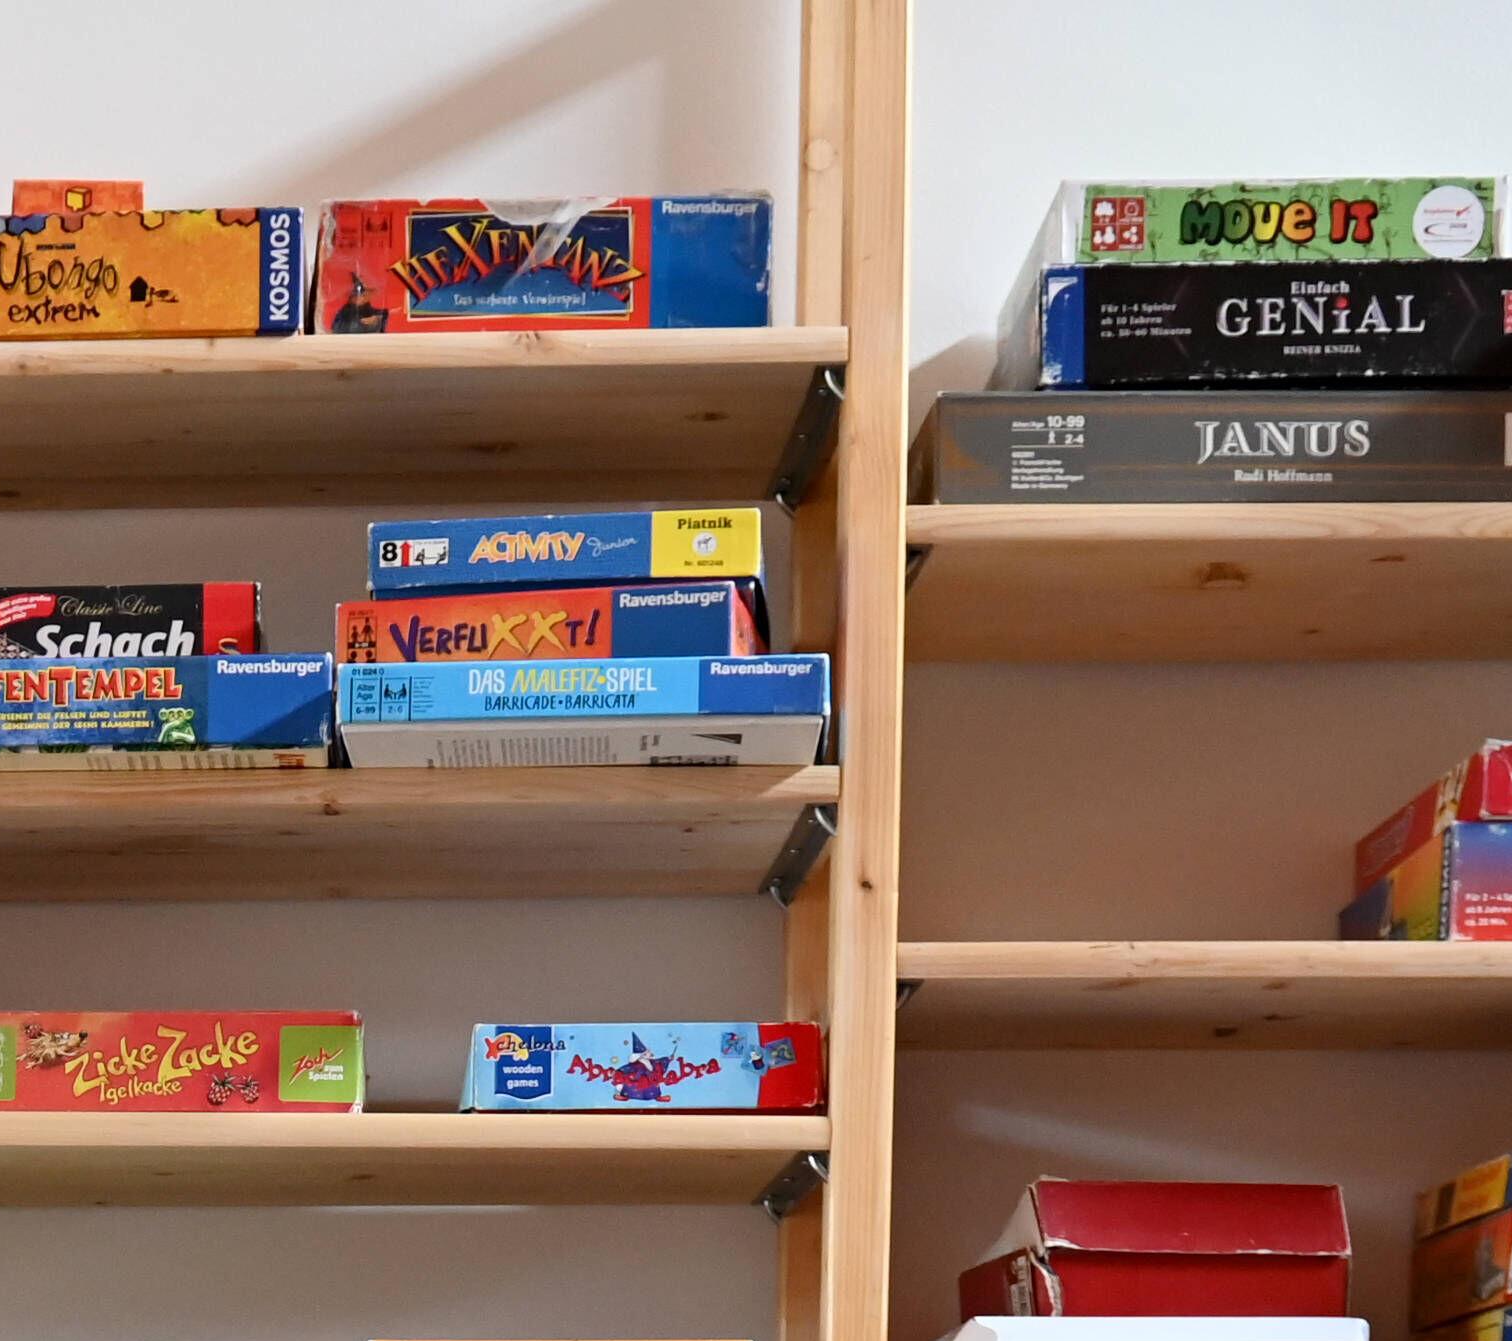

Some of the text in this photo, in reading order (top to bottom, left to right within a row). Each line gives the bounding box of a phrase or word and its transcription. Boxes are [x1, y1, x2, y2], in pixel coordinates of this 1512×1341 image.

[1329, 198, 1377, 242] IT
[269, 212, 290, 321] KOSMOS
[1290, 280, 1350, 295] Einfach
[8, 302, 100, 324] extrem
[1195, 420, 1371, 464] JANUS
[677, 517, 732, 531] Piatnik
[469, 532, 585, 563] ACTIVITY
[34, 622, 195, 658] Schach
[66, 1023, 259, 1091] Zicke Zacke
[503, 1065, 542, 1074] wooden
[507, 1078, 538, 1089] games
